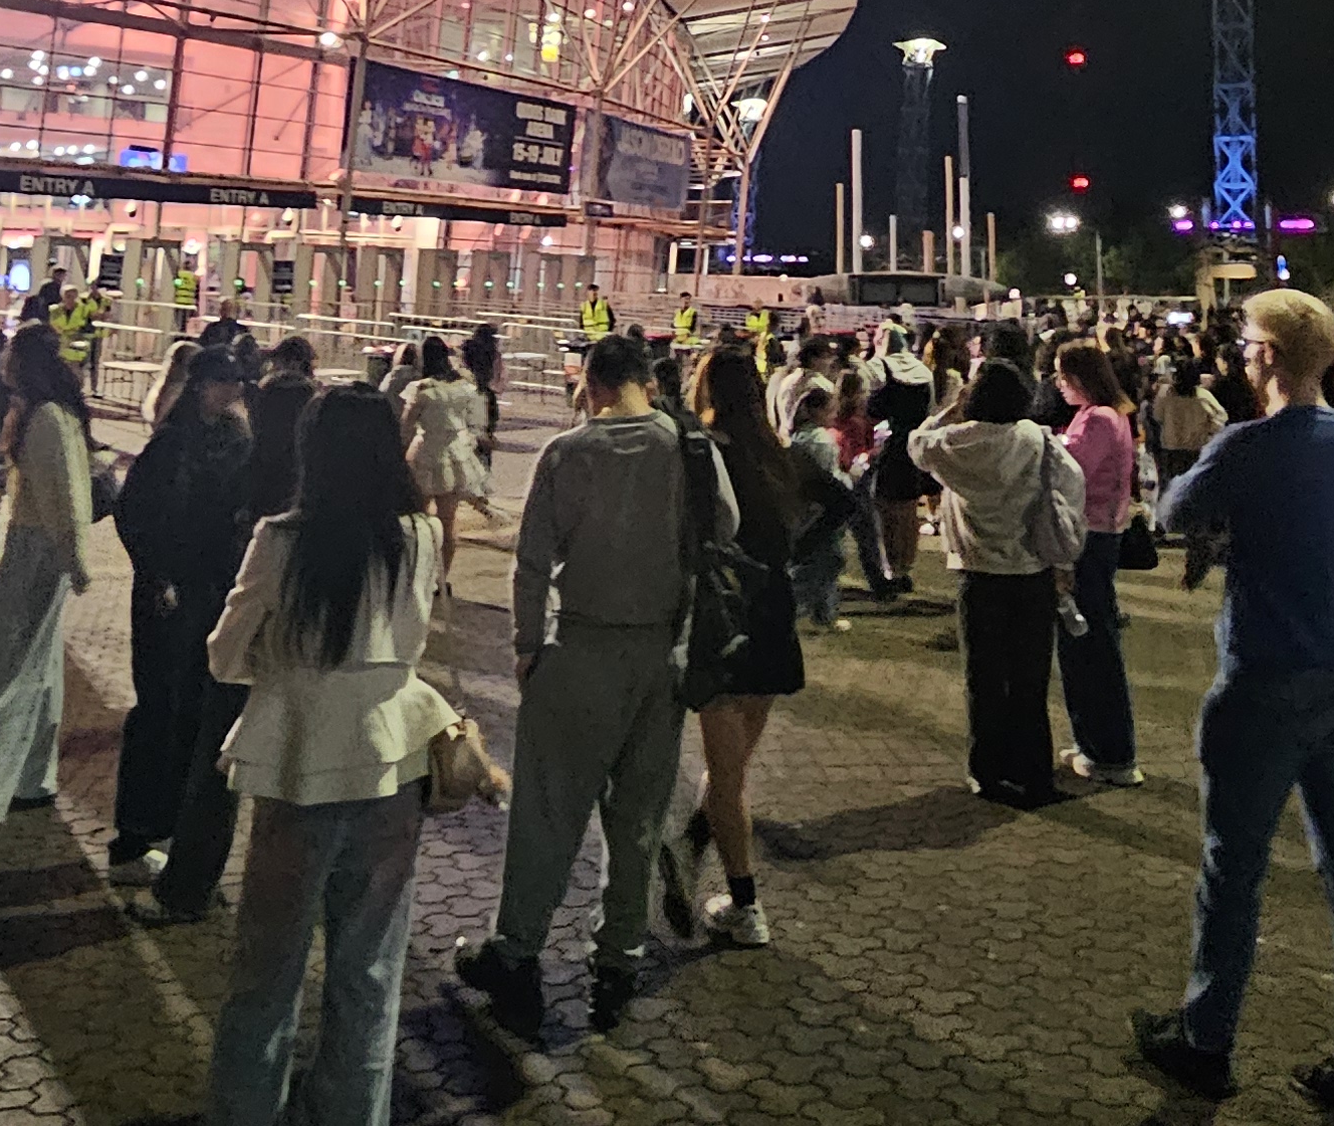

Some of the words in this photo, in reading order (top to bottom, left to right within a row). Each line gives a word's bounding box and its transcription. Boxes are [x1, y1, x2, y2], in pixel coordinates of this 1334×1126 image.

[20, 175, 78, 193] ENTRY
[82, 180, 94, 196] A
[210, 188, 256, 204] ENTRY
[259, 191, 269, 205] A
